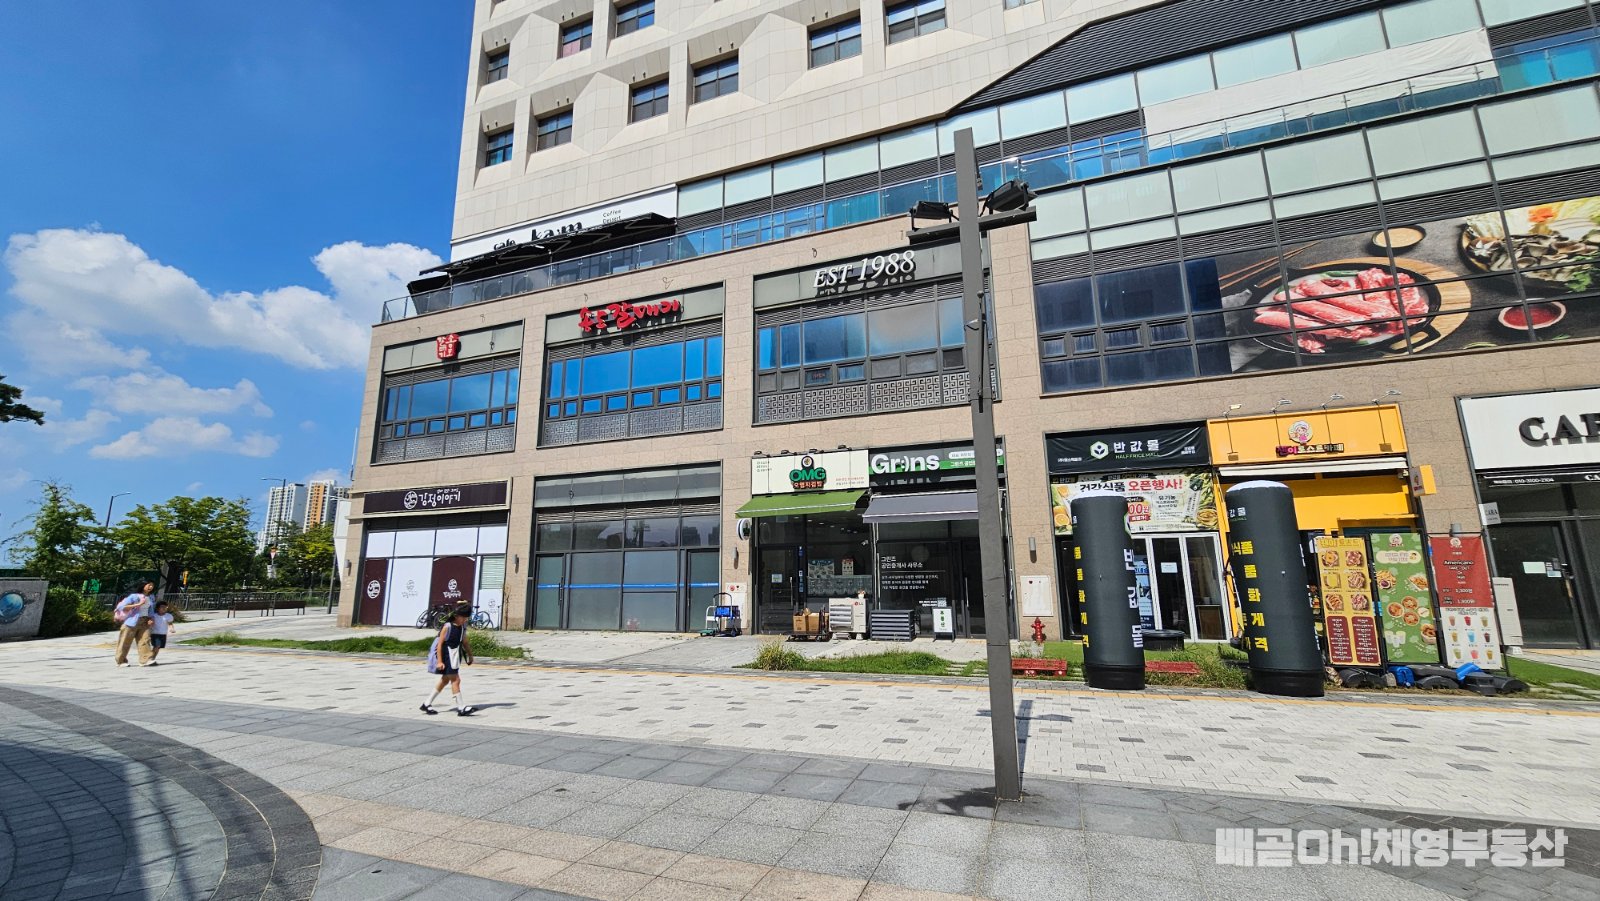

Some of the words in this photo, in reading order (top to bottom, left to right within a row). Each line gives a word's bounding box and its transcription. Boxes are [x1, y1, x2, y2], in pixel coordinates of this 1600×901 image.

[813, 264, 853, 288] EST
[857, 250, 915, 281] 1988
[790, 467, 827, 482] OMG
[1128, 479, 1183, 491] 오픈행사!
